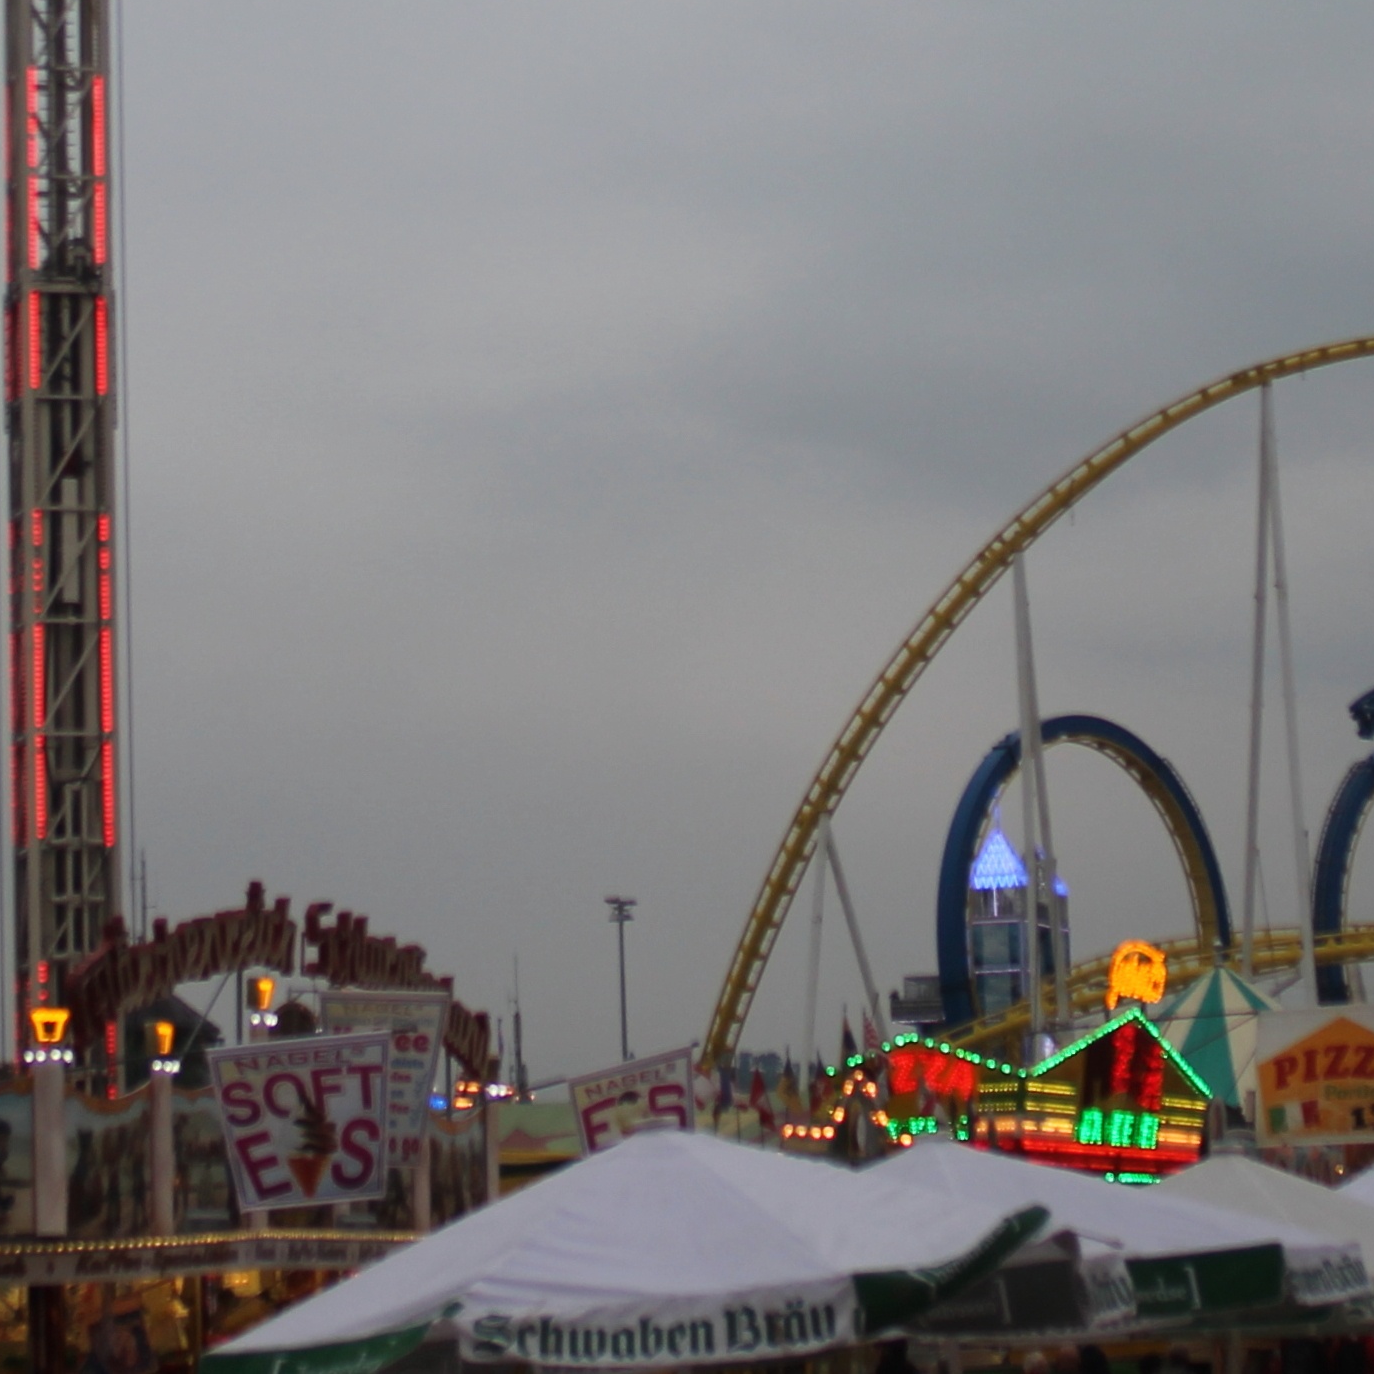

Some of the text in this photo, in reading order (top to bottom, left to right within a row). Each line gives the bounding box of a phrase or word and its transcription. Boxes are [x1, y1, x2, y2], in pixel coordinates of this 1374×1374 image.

[889, 1050, 975, 1103] ZZA
[473, 1315, 715, 1359] Schwaben
[724, 1299, 837, 1351] Bräu
